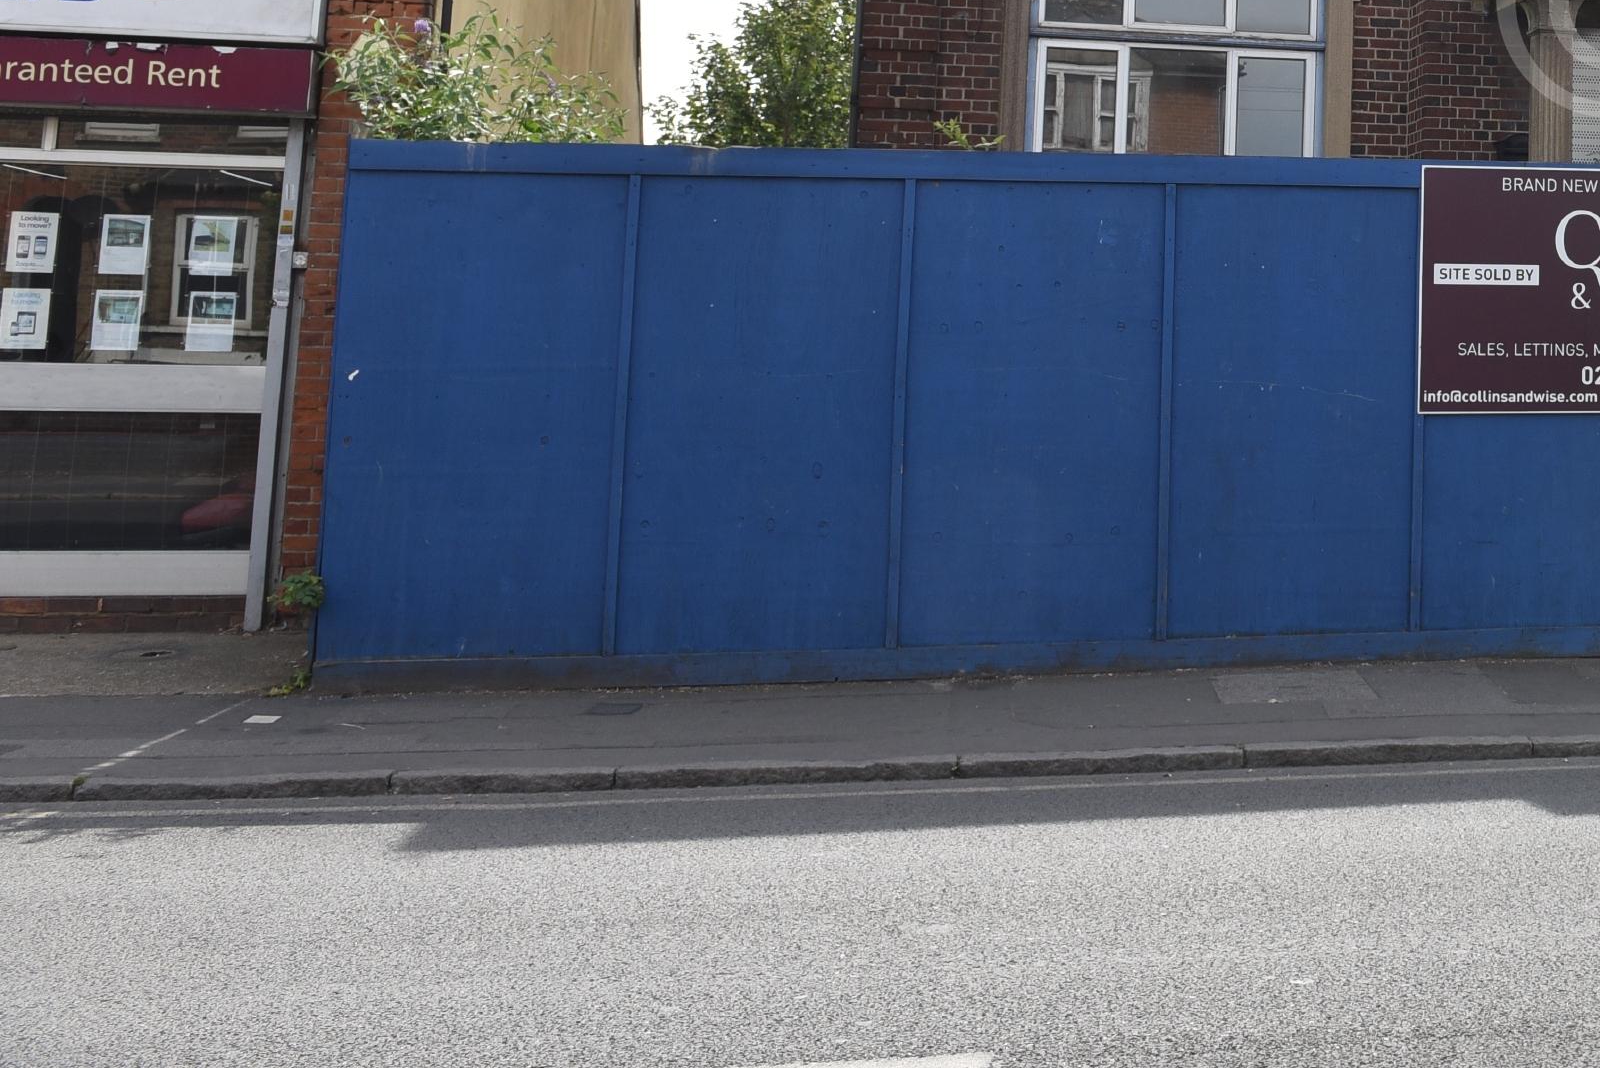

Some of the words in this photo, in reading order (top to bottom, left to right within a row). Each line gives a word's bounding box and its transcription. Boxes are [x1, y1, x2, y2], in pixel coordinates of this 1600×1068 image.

[0, 58, 134, 85] ranteed
[147, 60, 221, 88] Rent
[1502, 177, 1557, 193] BRAND
[1562, 179, 1599, 193] NEW
[1439, 267, 1471, 281] SITE
[1475, 268, 1512, 282] SOLD
[1516, 269, 1534, 282] BY
[1570, 282, 1592, 310] &
[1457, 342, 1509, 357] SALES,
[1514, 342, 1589, 358] LETTINGS,
[1423, 389, 1598, 403] info@collinsandwise.com
